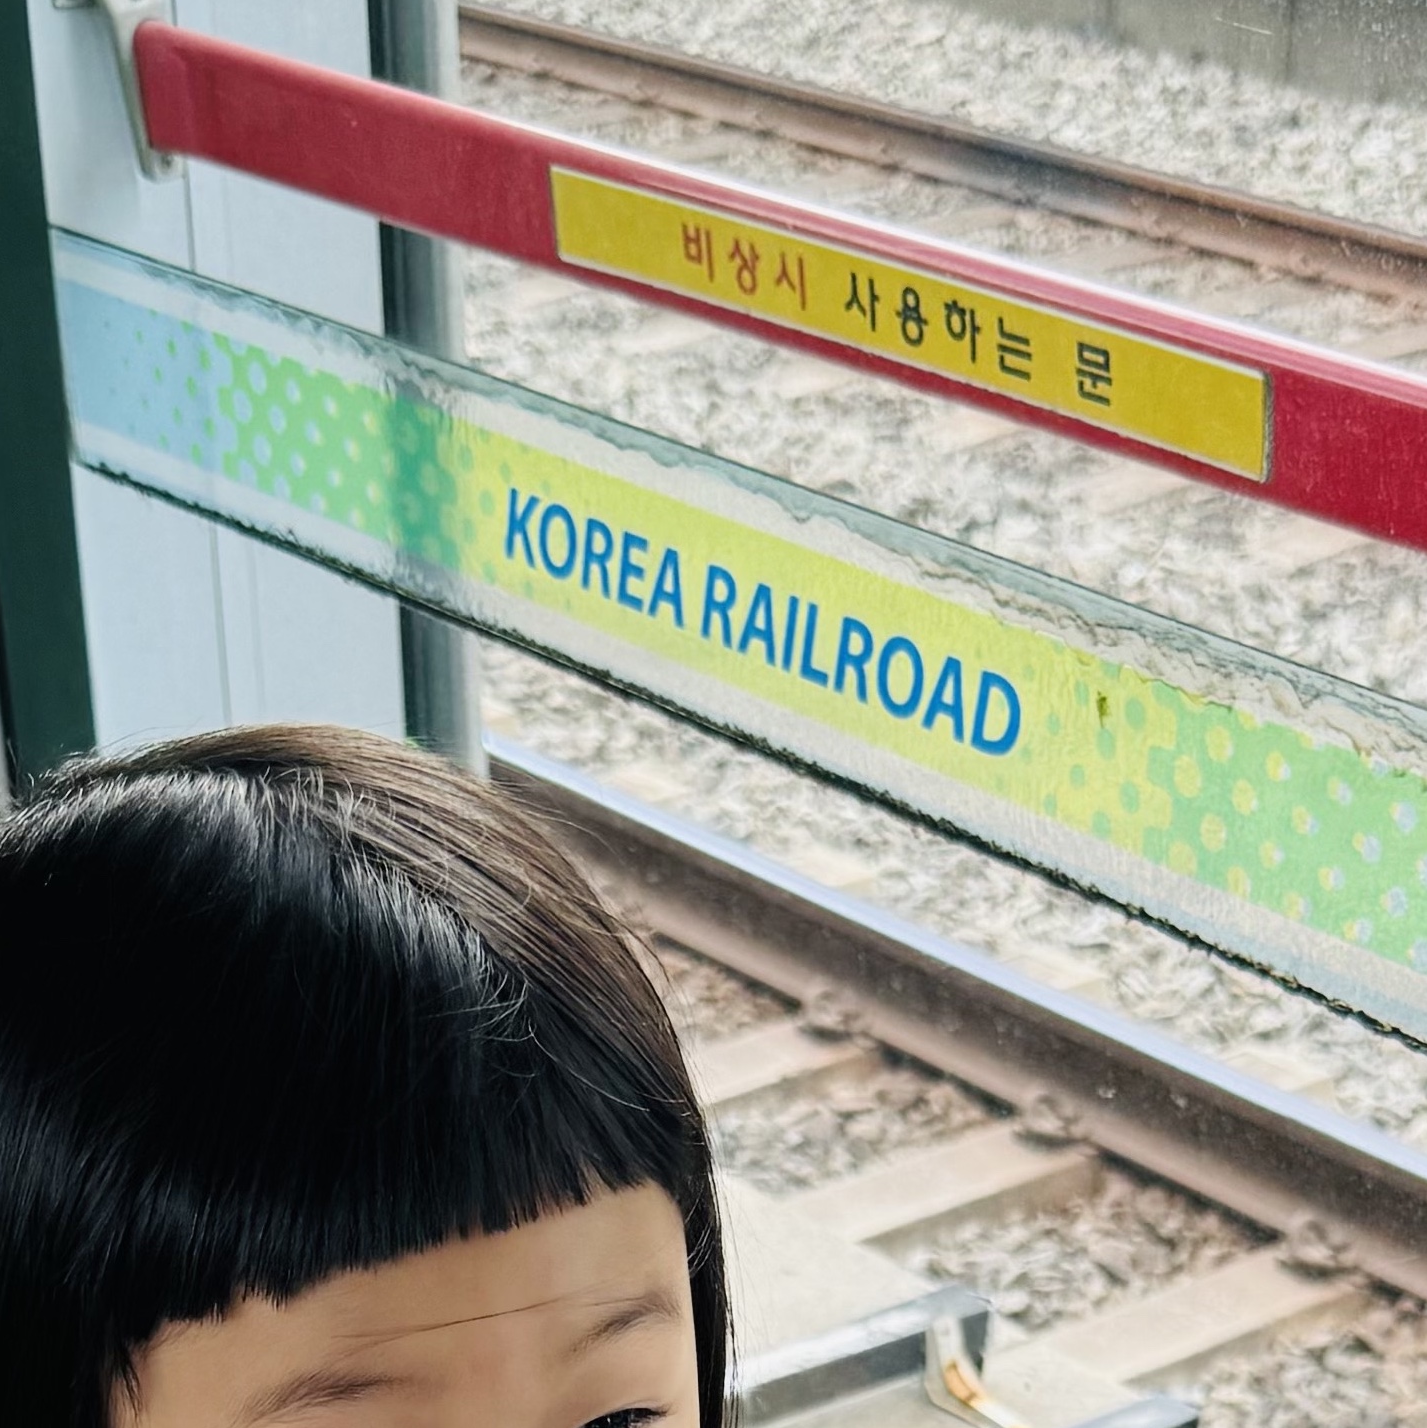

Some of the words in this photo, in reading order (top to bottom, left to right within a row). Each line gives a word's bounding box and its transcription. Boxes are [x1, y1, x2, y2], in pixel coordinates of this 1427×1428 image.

[681, 222, 808, 311] 비상시
[844, 271, 1034, 382] 사용하는
[1075, 340, 1113, 407] 문
[504, 487, 685, 629] KOREA
[700, 564, 1023, 757] RAILROAD
